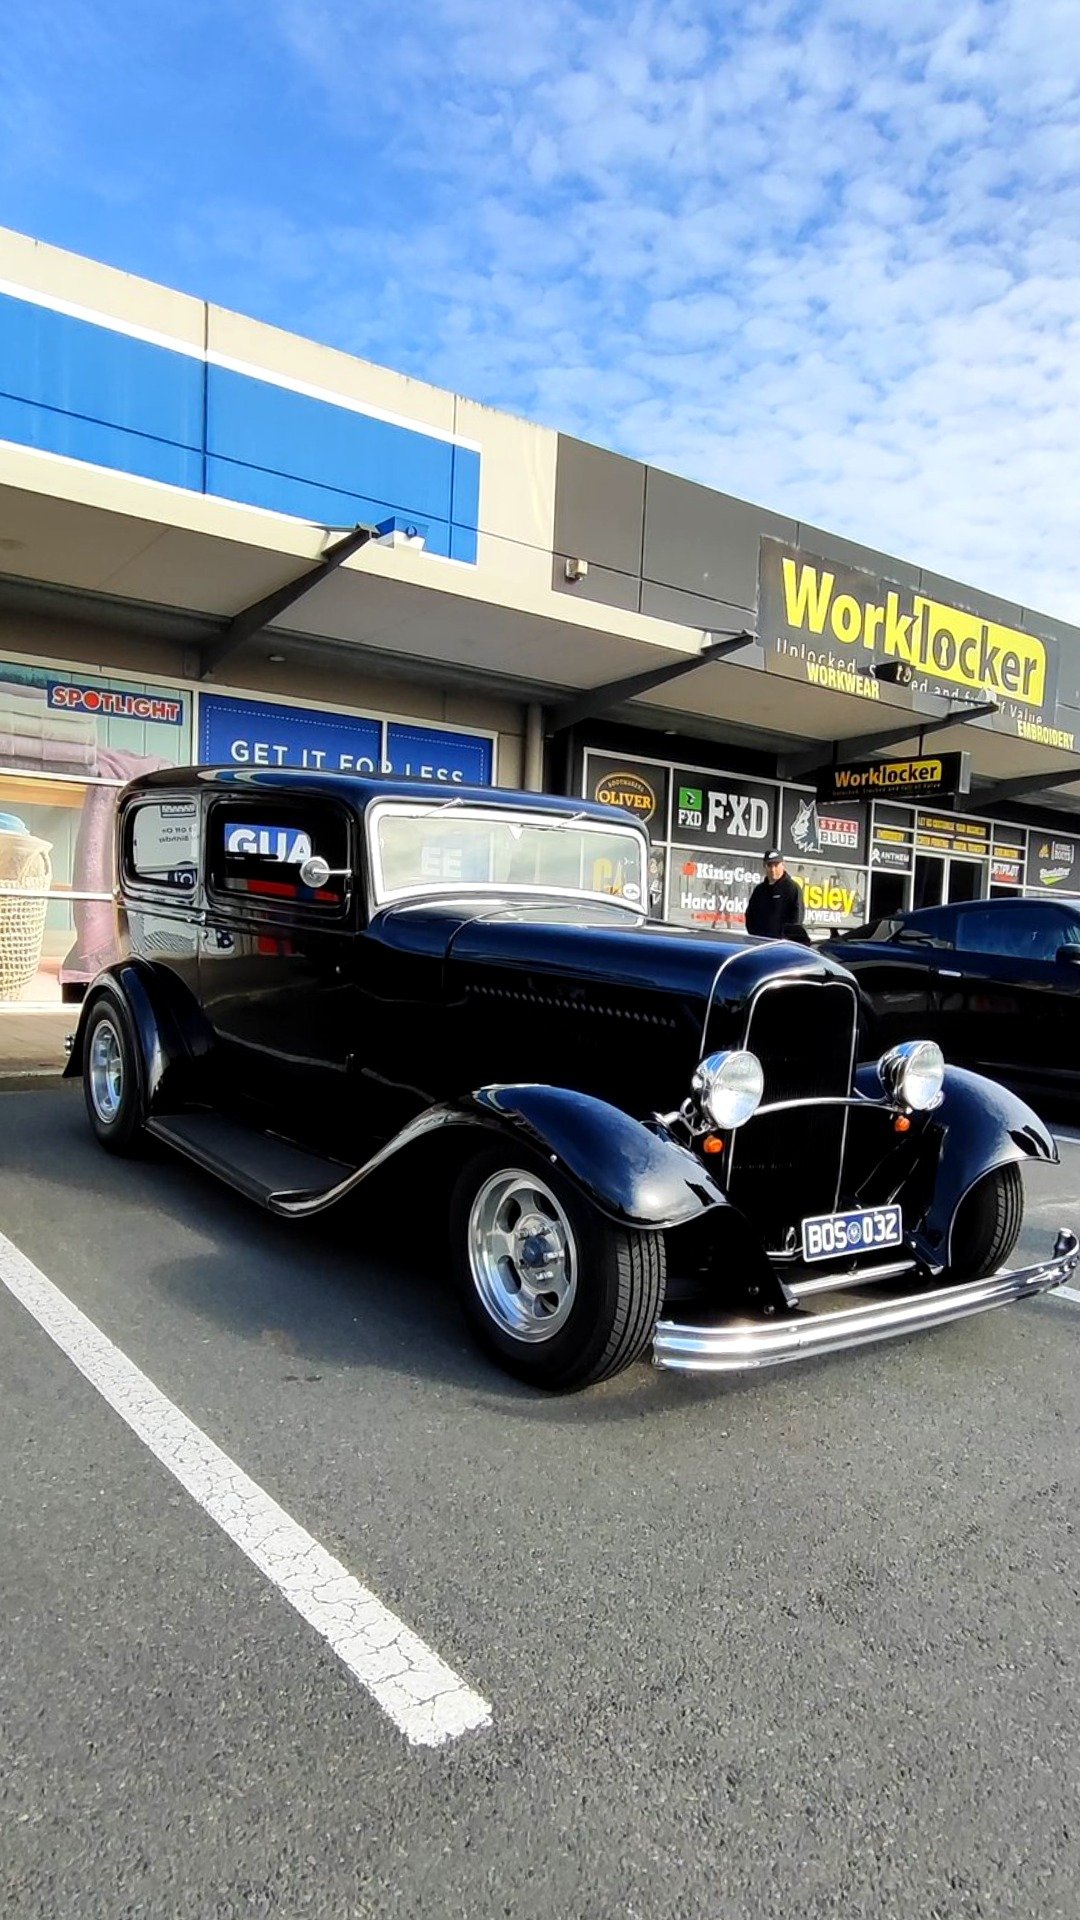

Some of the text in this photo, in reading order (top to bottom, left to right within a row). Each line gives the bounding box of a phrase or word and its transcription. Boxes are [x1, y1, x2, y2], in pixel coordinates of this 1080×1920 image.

[782, 557, 1038, 697] Worklocker
[806, 661, 880, 699] WORKWEAR
[52, 685, 180, 722] SPOTLIGHT
[1017, 719, 1075, 750] EMBROIDERY
[231, 740, 288, 766] GET
[302, 748, 326, 769] IT
[835, 763, 938, 788] Worklocker
[599, 789, 652, 809] OLIVER
[678, 809, 702, 827] FXD
[819, 818, 858, 833] STEEL
[820, 831, 858, 846] BLUE
[696, 861, 761, 885] KingGee
[680, 891, 716, 912] Hard
[807, 1212, 898, 1255] BOS 032
